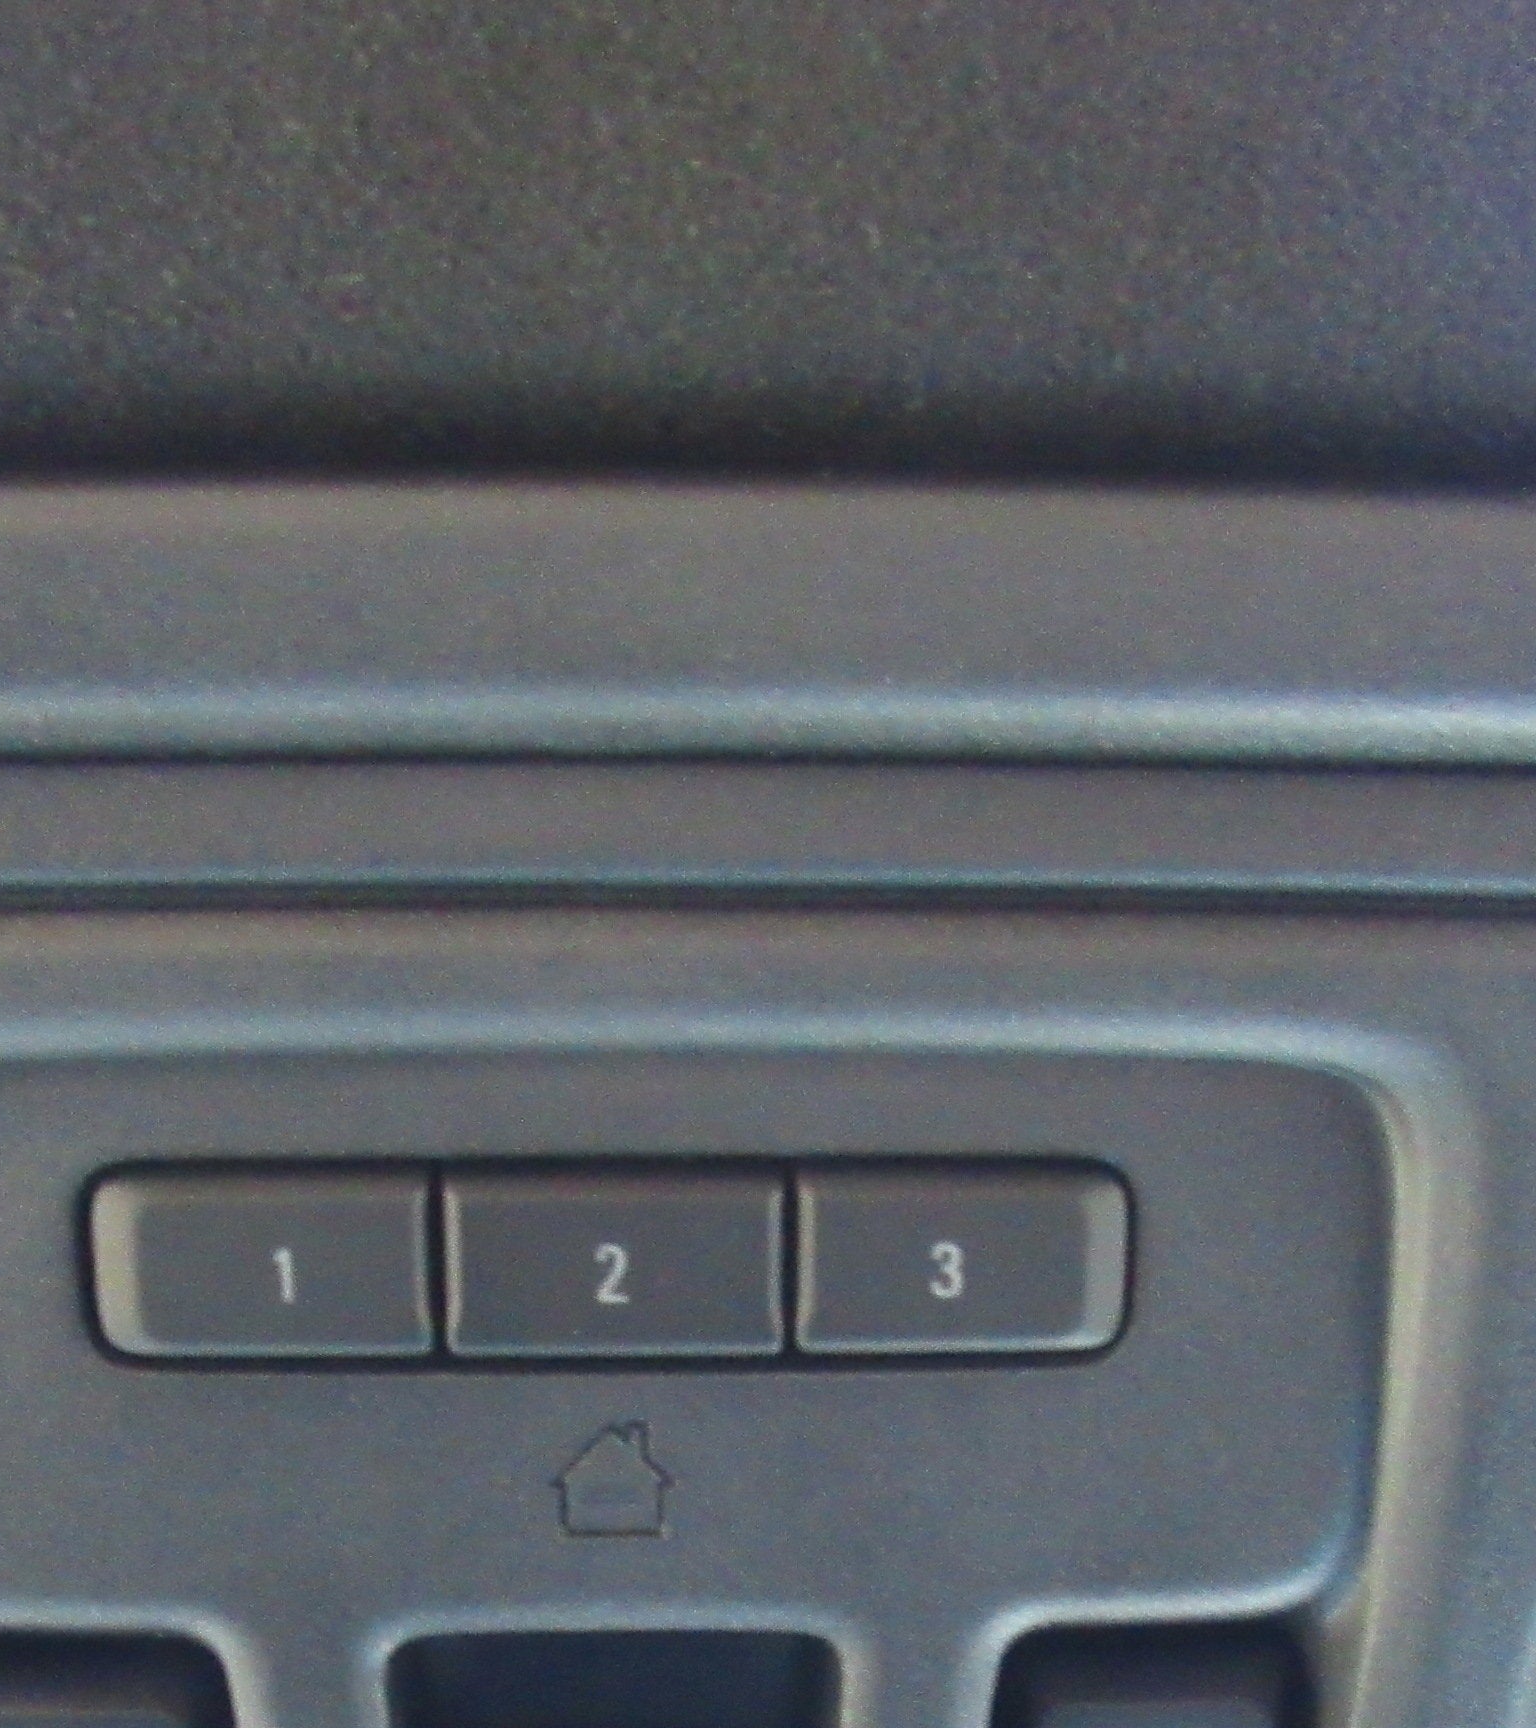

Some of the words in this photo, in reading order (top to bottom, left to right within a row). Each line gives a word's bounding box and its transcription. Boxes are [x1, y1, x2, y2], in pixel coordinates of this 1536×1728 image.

[272, 1246, 297, 1305] 1
[593, 1242, 631, 1305] 2
[927, 1240, 965, 1300] 3
